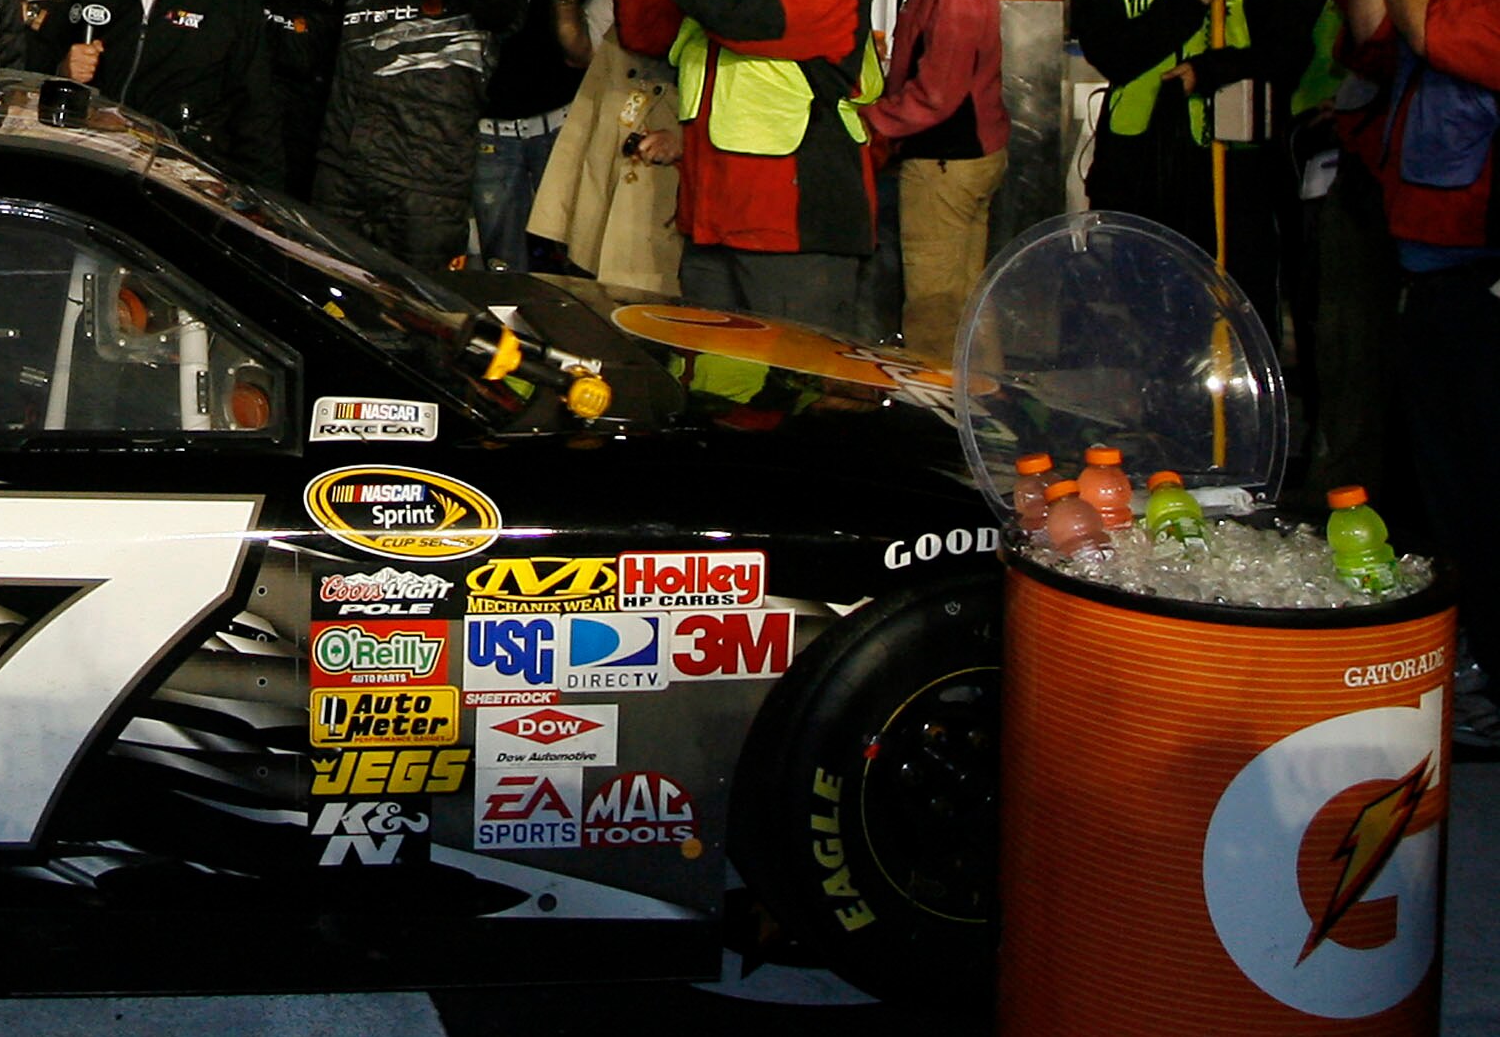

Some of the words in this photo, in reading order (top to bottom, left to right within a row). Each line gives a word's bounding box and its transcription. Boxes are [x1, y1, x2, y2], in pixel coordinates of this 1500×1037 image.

[360, 403, 418, 421] NASCAR
[318, 424, 376, 437] RACE
[381, 423, 427, 437] CAR
[360, 483, 425, 502] NASCAR
[372, 504, 437, 530] Sprint
[381, 536, 415, 548] CUP
[320, 573, 384, 602] Coors
[384, 576, 454, 602] LIGHT
[624, 556, 762, 606] Holley
[338, 603, 433, 615] POLE
[467, 595, 561, 614] MECHANIX
[562, 594, 617, 613] WEAR
[624, 596, 656, 609] HP
[658, 593, 736, 608] CARBS
[320, 630, 437, 669] O'Reilly
[468, 618, 555, 686] USG
[672, 613, 789, 676] 3M
[351, 673, 376, 684] AUTO
[377, 672, 407, 683] PARTS
[1343, 646, 1448, 689] GATORADE
[566, 671, 660, 690] DIRECTV
[353, 693, 432, 713] Auto
[465, 691, 557, 705] SHEETROCK
[347, 715, 449, 736] Meter
[496, 751, 525, 763] Dow
[527, 750, 598, 763] Automotive
[311, 749, 471, 795] JEGS
[486, 775, 574, 820] EA
[587, 773, 694, 823] MAC
[311, 801, 430, 835] K&
[479, 822, 577, 847] SPORTS
[584, 826, 694, 845] TOOLS
[318, 835, 405, 866] N
[810, 767, 877, 932] EAGLE
[1203, 686, 1444, 1020] G
